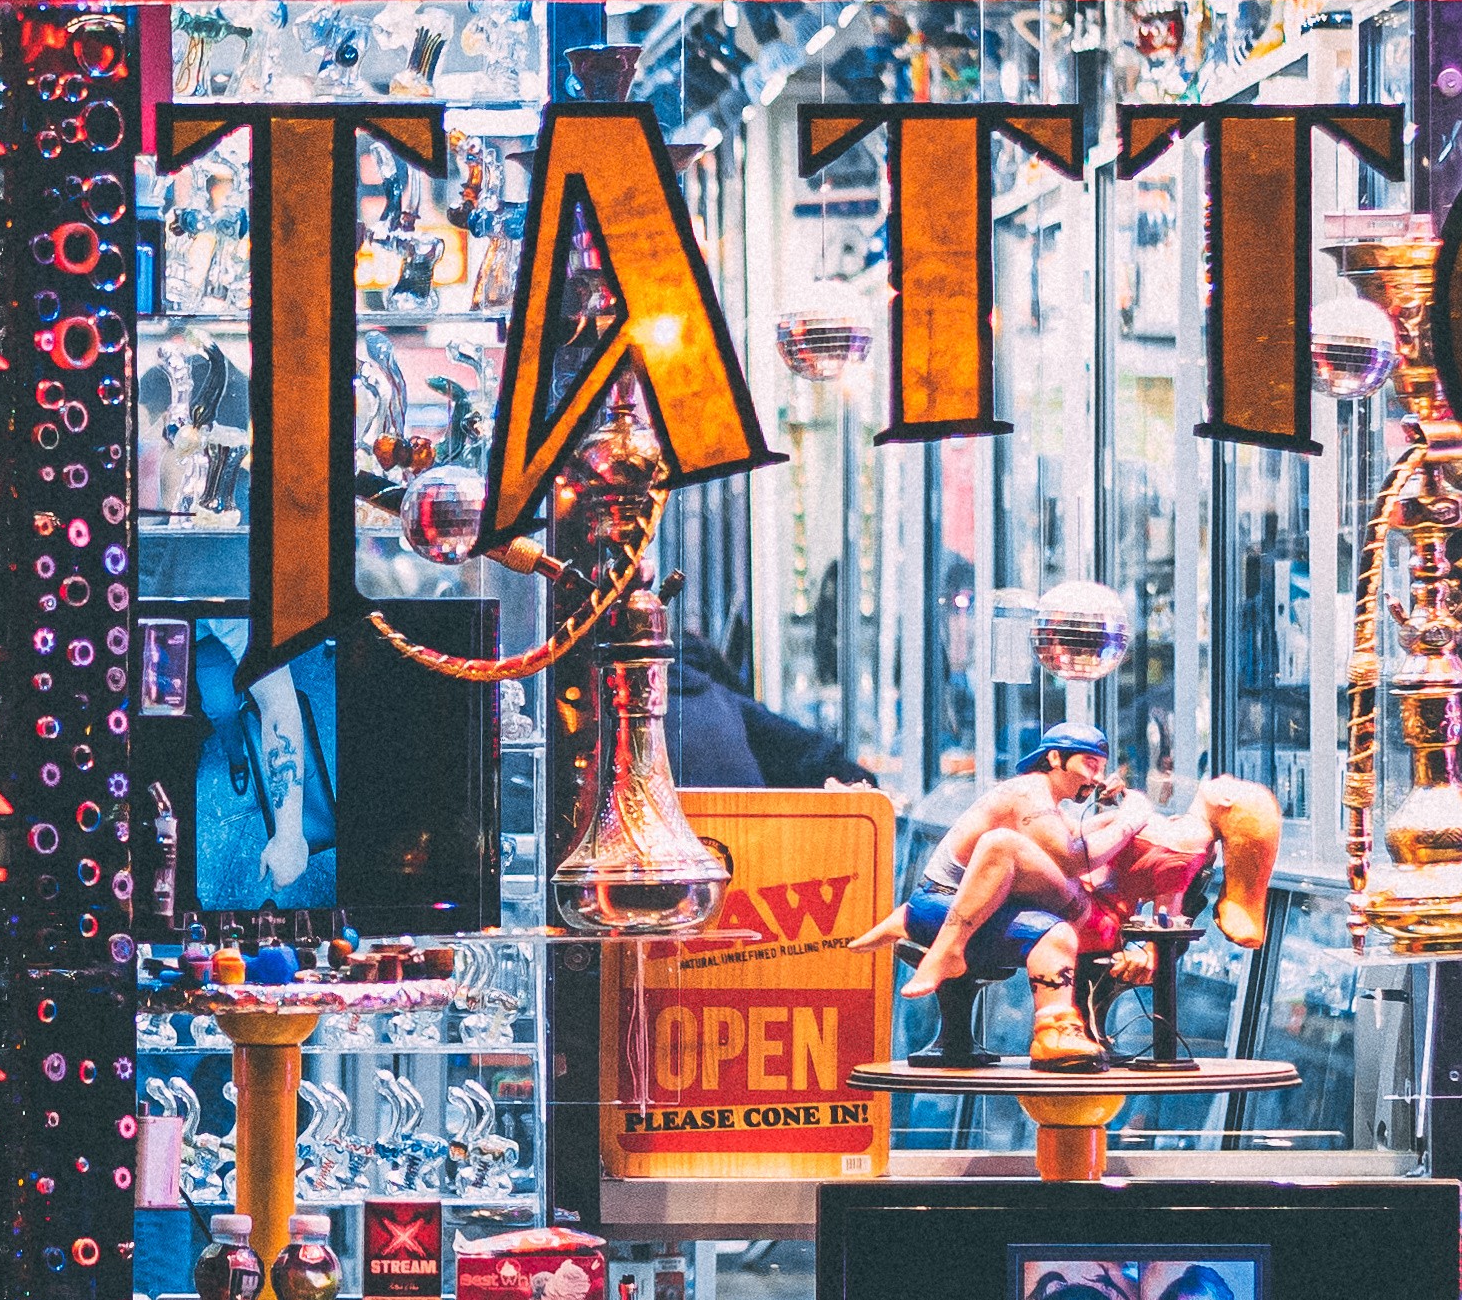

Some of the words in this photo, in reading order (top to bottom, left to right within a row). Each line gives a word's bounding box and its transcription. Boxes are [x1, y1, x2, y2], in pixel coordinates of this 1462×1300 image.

[720, 947, 778, 967] UNREFINED
[779, 942, 820, 956] ROLLING
[653, 1004, 839, 1092] OPEN
[624, 1108, 736, 1133] PLEASE
[742, 1106, 812, 1129] CONE
[829, 1103, 870, 1124] IN!
[370, 1259, 439, 1275] STREAM
